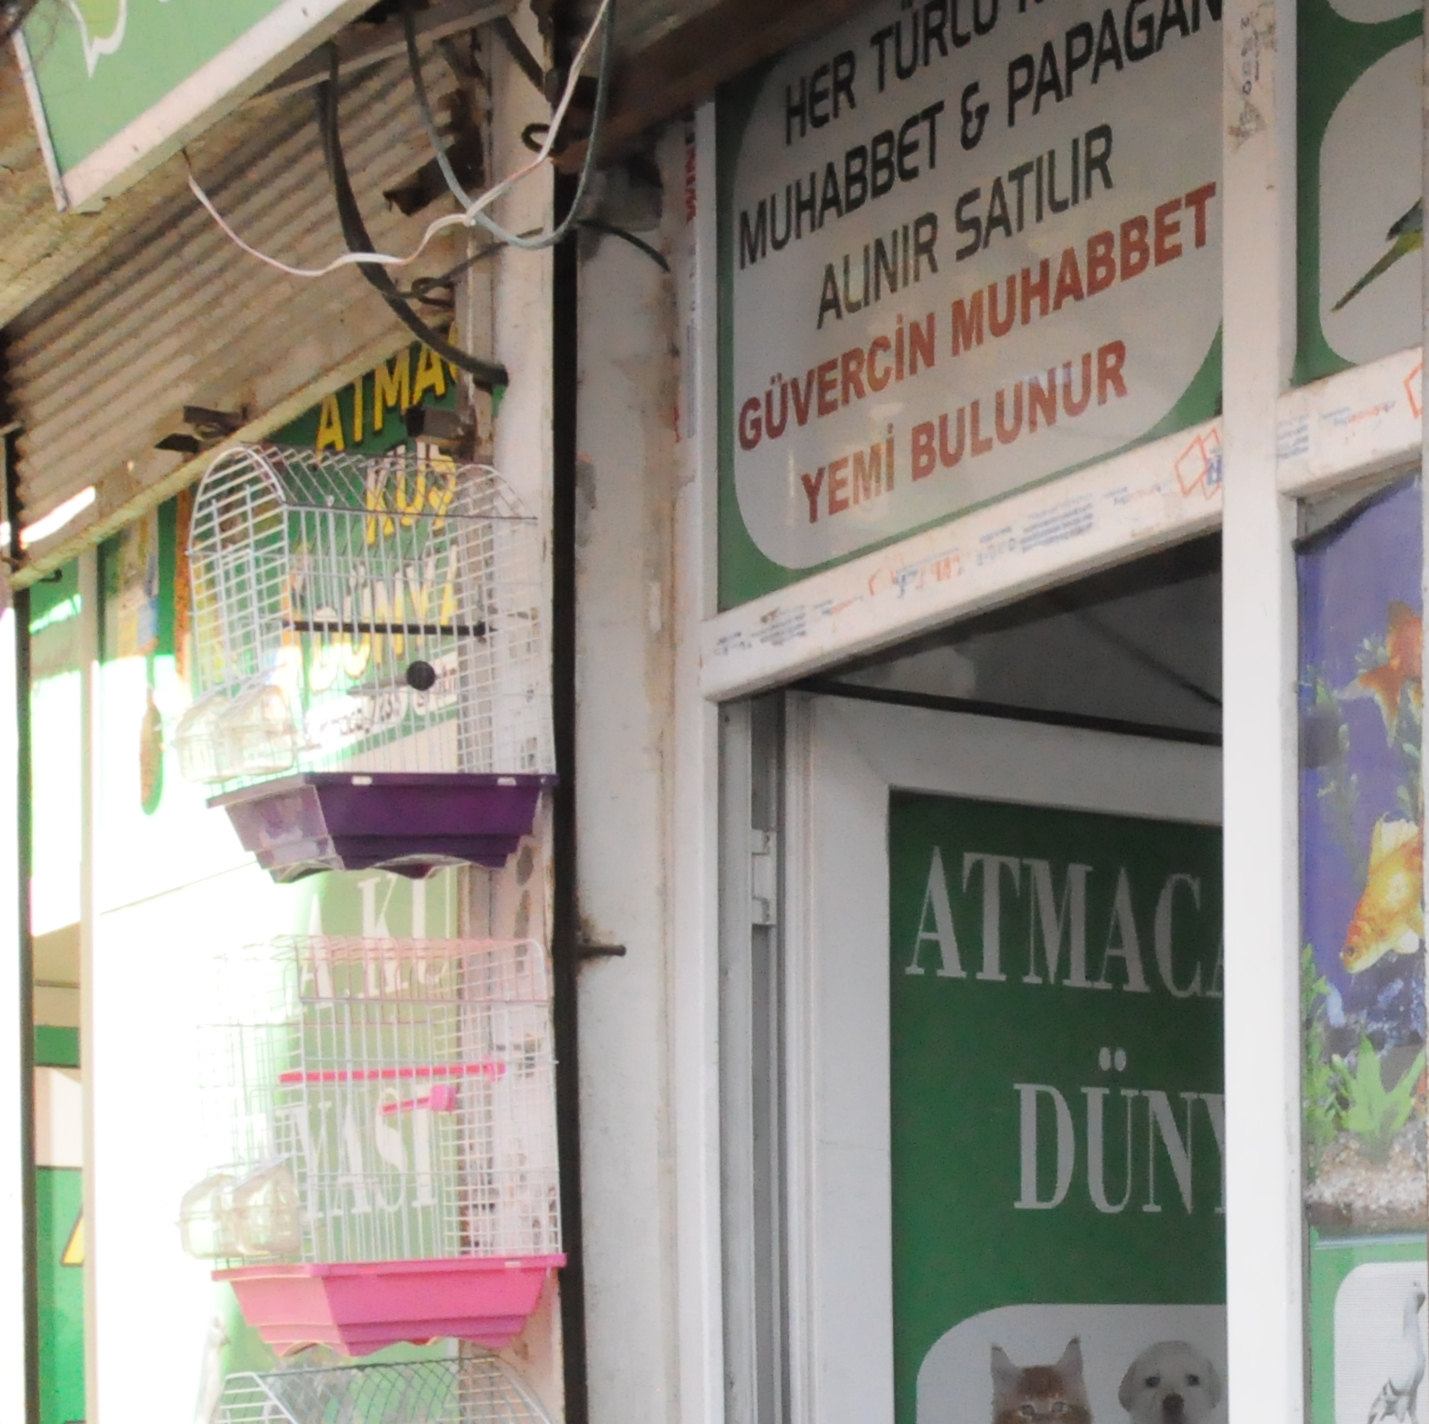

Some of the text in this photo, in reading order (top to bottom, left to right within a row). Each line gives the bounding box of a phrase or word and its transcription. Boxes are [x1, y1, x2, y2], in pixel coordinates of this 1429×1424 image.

[738, 100, 945, 271] MUHABBET
[960, 81, 990, 151] &
[786, 49, 857, 146] HER
[738, 181, 1218, 453] GÜVERCİN MUHABBET
[816, 123, 1115, 330] ALINIR SATILIR
[315, 321, 458, 461] ATMA
[801, 422, 896, 525] YEMİ
[910, 339, 1129, 483] BULUNUR
[904, 845, 1224, 998] ATMAC
